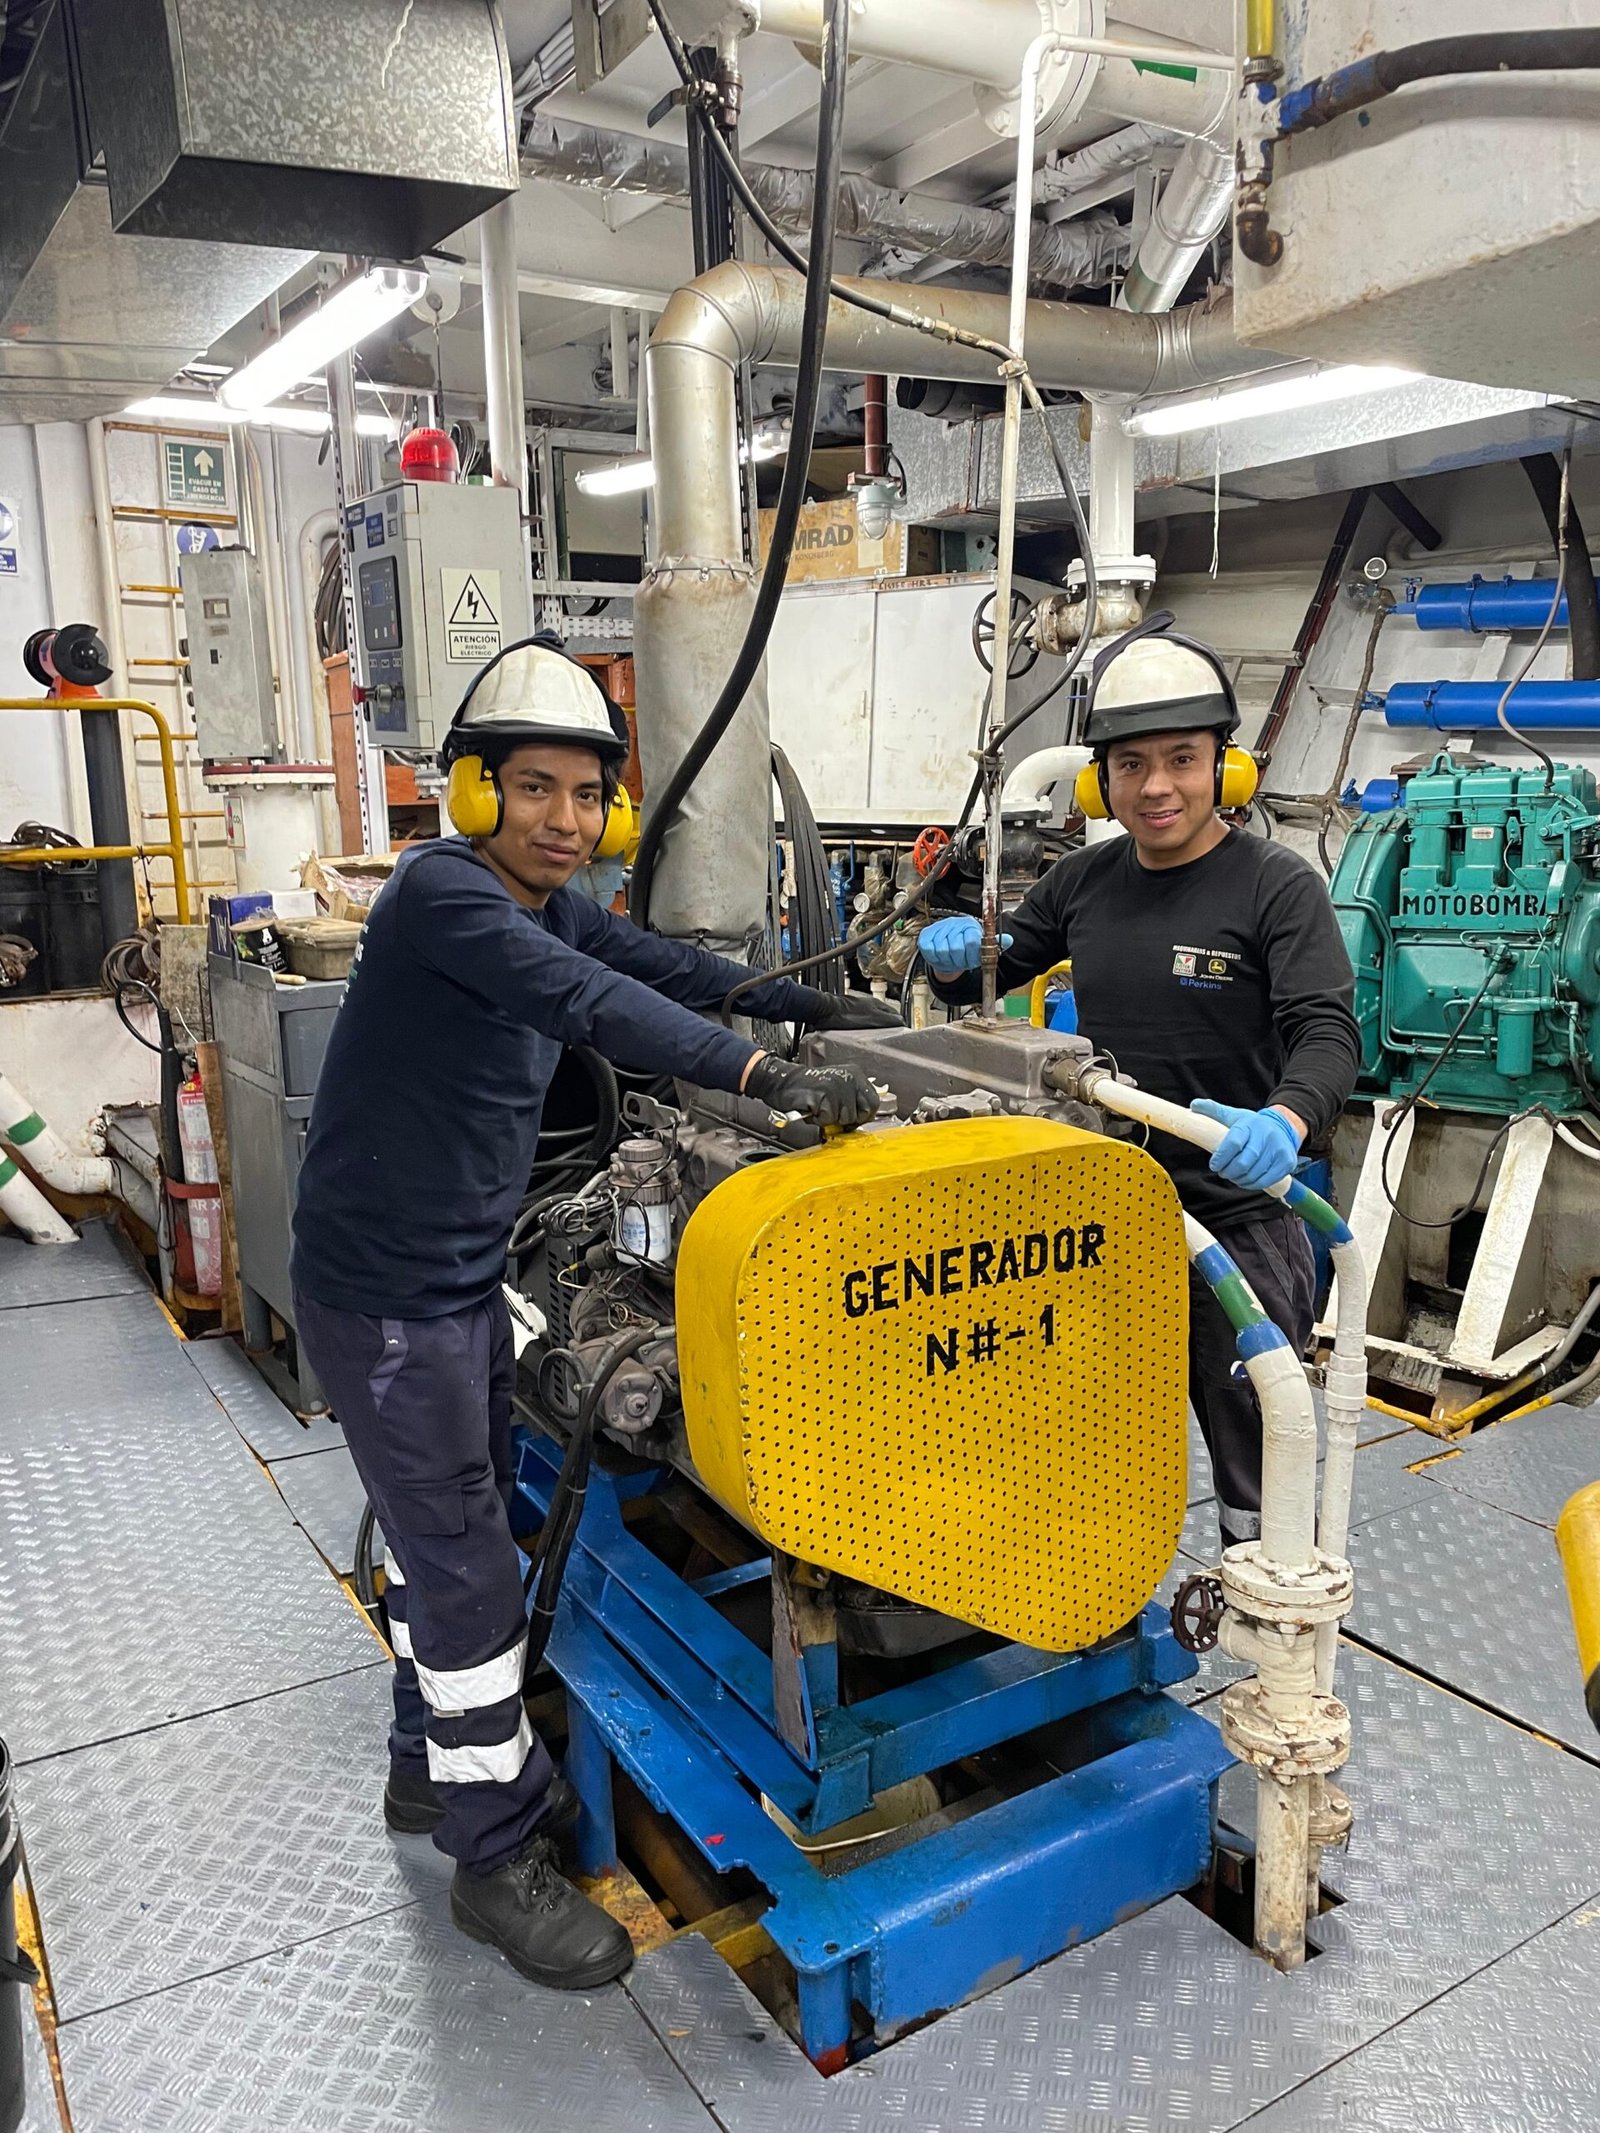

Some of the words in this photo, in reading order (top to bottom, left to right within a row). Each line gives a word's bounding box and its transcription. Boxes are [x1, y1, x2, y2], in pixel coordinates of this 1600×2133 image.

[188, 478, 211, 487] EVACUE
[453, 635, 497, 643] ATENCIÓN
[1188, 979, 1222, 990] Perkins
[844, 1223, 1106, 1318] GENERADOR
